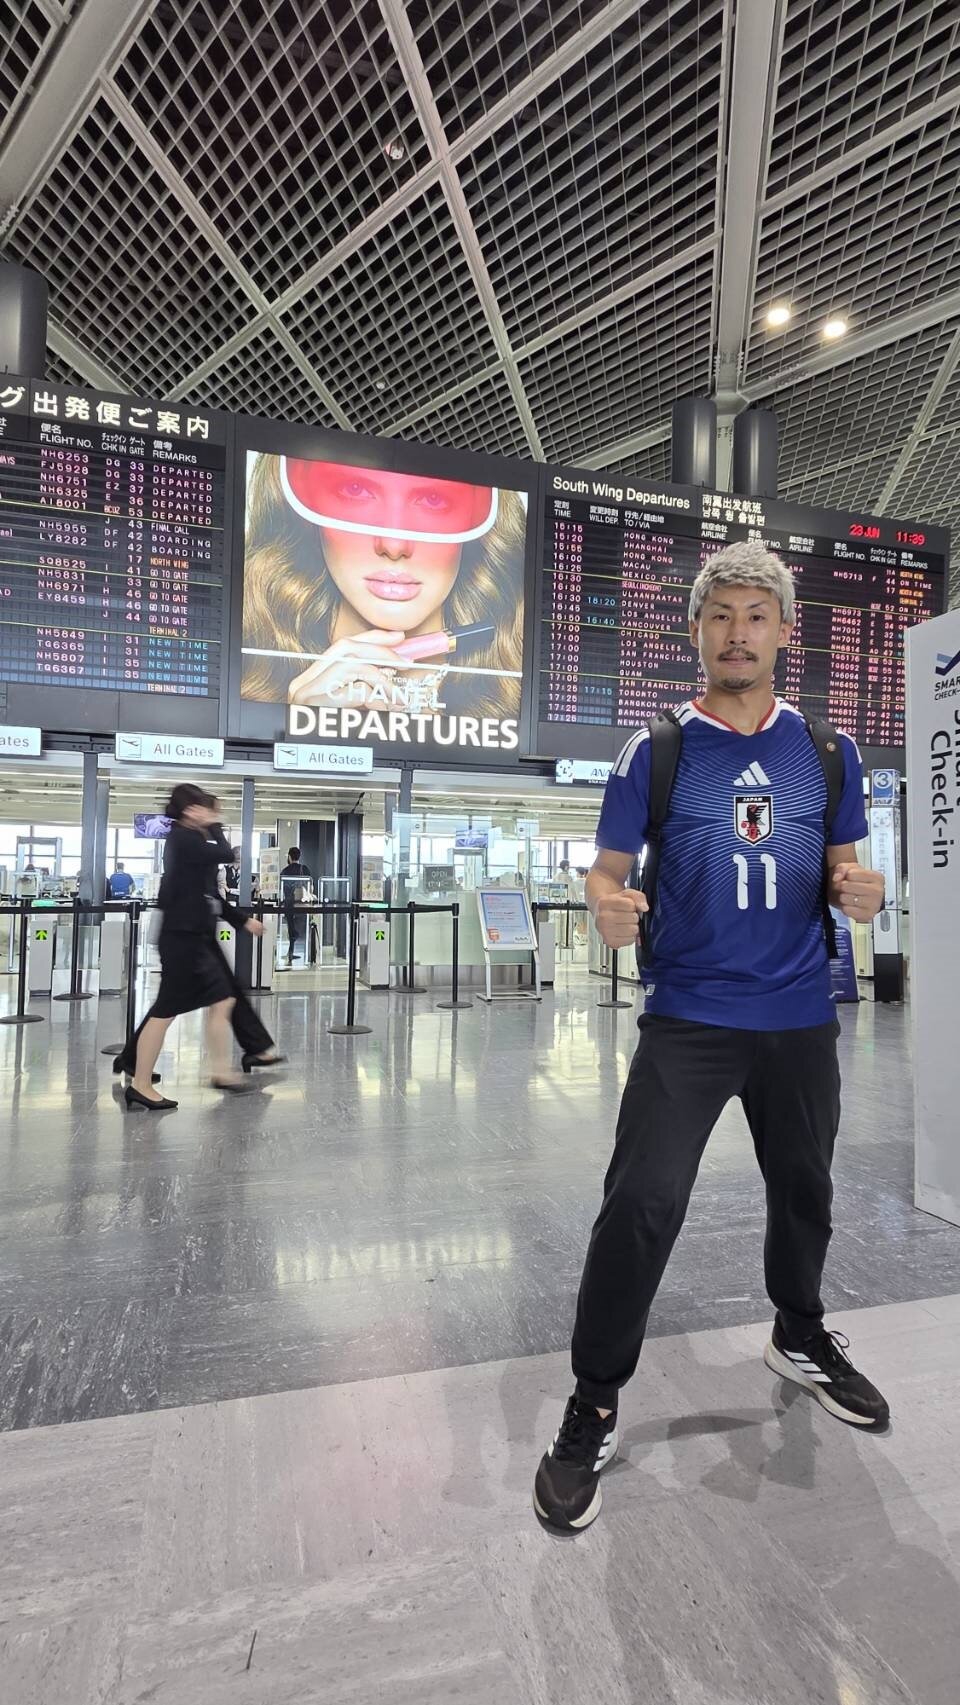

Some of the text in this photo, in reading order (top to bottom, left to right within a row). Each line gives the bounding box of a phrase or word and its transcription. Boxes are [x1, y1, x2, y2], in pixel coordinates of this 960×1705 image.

[41, 422, 62, 434] 便名
[40, 433, 94, 448] FLIGHT NO.
[101, 442, 145, 456] CHK IN GATE
[152, 449, 197, 464] REMARKS
[130, 461, 144, 471] 33
[153, 465, 213, 480] DEPARTED
[129, 473, 144, 483] 33
[153, 476, 212, 491] DEPARTED
[129, 484, 144, 494] 37
[553, 476, 690, 509] South Wing Departures
[153, 488, 212, 503] DEPARTED
[128, 496, 144, 506] 36
[152, 500, 212, 514] DEPARTED
[554, 508, 571, 518] TIME
[152, 511, 212, 526] DEPARTED
[589, 514, 604, 523] WILL
[128, 520, 143, 529] 43
[151, 523, 190, 535] FINAL CALL
[128, 531, 143, 541] 42
[701, 530, 726, 540] AIRLINE
[849, 524, 880, 538] 23 JUN
[40, 532, 87, 546] LY8282
[151, 534, 211, 548] BOARDING
[624, 532, 673, 544] HONG KONG
[127, 543, 143, 553] 42
[624, 541, 667, 553] SHANGHAI
[789, 544, 813, 553] AIRLINE
[151, 546, 211, 559] BOARDING
[834, 550, 855, 559] FLIGHT
[128, 555, 142, 564] 17
[623, 552, 673, 564] HONG KONG
[622, 561, 651, 570] MACAU
[900, 560, 928, 570] REMARKS
[127, 566, 140, 575] 41
[150, 569, 189, 581] GO TO GATE
[127, 578, 142, 587] 33
[622, 571, 684, 584] MEXICO CITY
[38, 580, 85, 593] NH6971
[149, 580, 188, 592] GO TO GATE
[38, 592, 86, 605] EY8459
[126, 590, 142, 599] 46
[622, 590, 682, 603] ULAANBAATAR
[126, 601, 141, 610] 46
[622, 600, 655, 610] DENVER
[126, 612, 141, 622] 44
[621, 610, 682, 622] LOS ANGELES
[551, 622, 580, 632] 17:00
[621, 620, 671, 631] VANCOUVER
[551, 633, 580, 642] 17:00
[620, 630, 660, 640] CHICAGO
[126, 636, 139, 645] 31
[149, 638, 208, 650] NEW TIME
[551, 643, 579, 652] 17:00
[643, 642, 681, 652] ANGELES
[786, 648, 805, 656] THAI
[36, 651, 85, 663] NH5807
[148, 649, 208, 661] NEW TIME
[550, 653, 578, 662] 17:00
[643, 652, 692, 662] FRANCISCO
[125, 659, 139, 668] 35
[620, 660, 659, 669] HOUSTON
[786, 657, 804, 665] THAI
[550, 663, 578, 672] 17:00
[620, 669, 642, 677] GUAM
[642, 681, 692, 691] FRANCISCO
[325, 681, 446, 709] CHANEL
[619, 689, 658, 698] TORONTO
[618, 699, 657, 708] BANGKOK
[289, 704, 519, 750] DEPARTURES
[154, 744, 214, 758] All Gates
[309, 752, 364, 766] All Gates
[877, 772, 888, 787] 3
[931, 731, 954, 868] Check-in
[733, 854, 776, 910] 11
